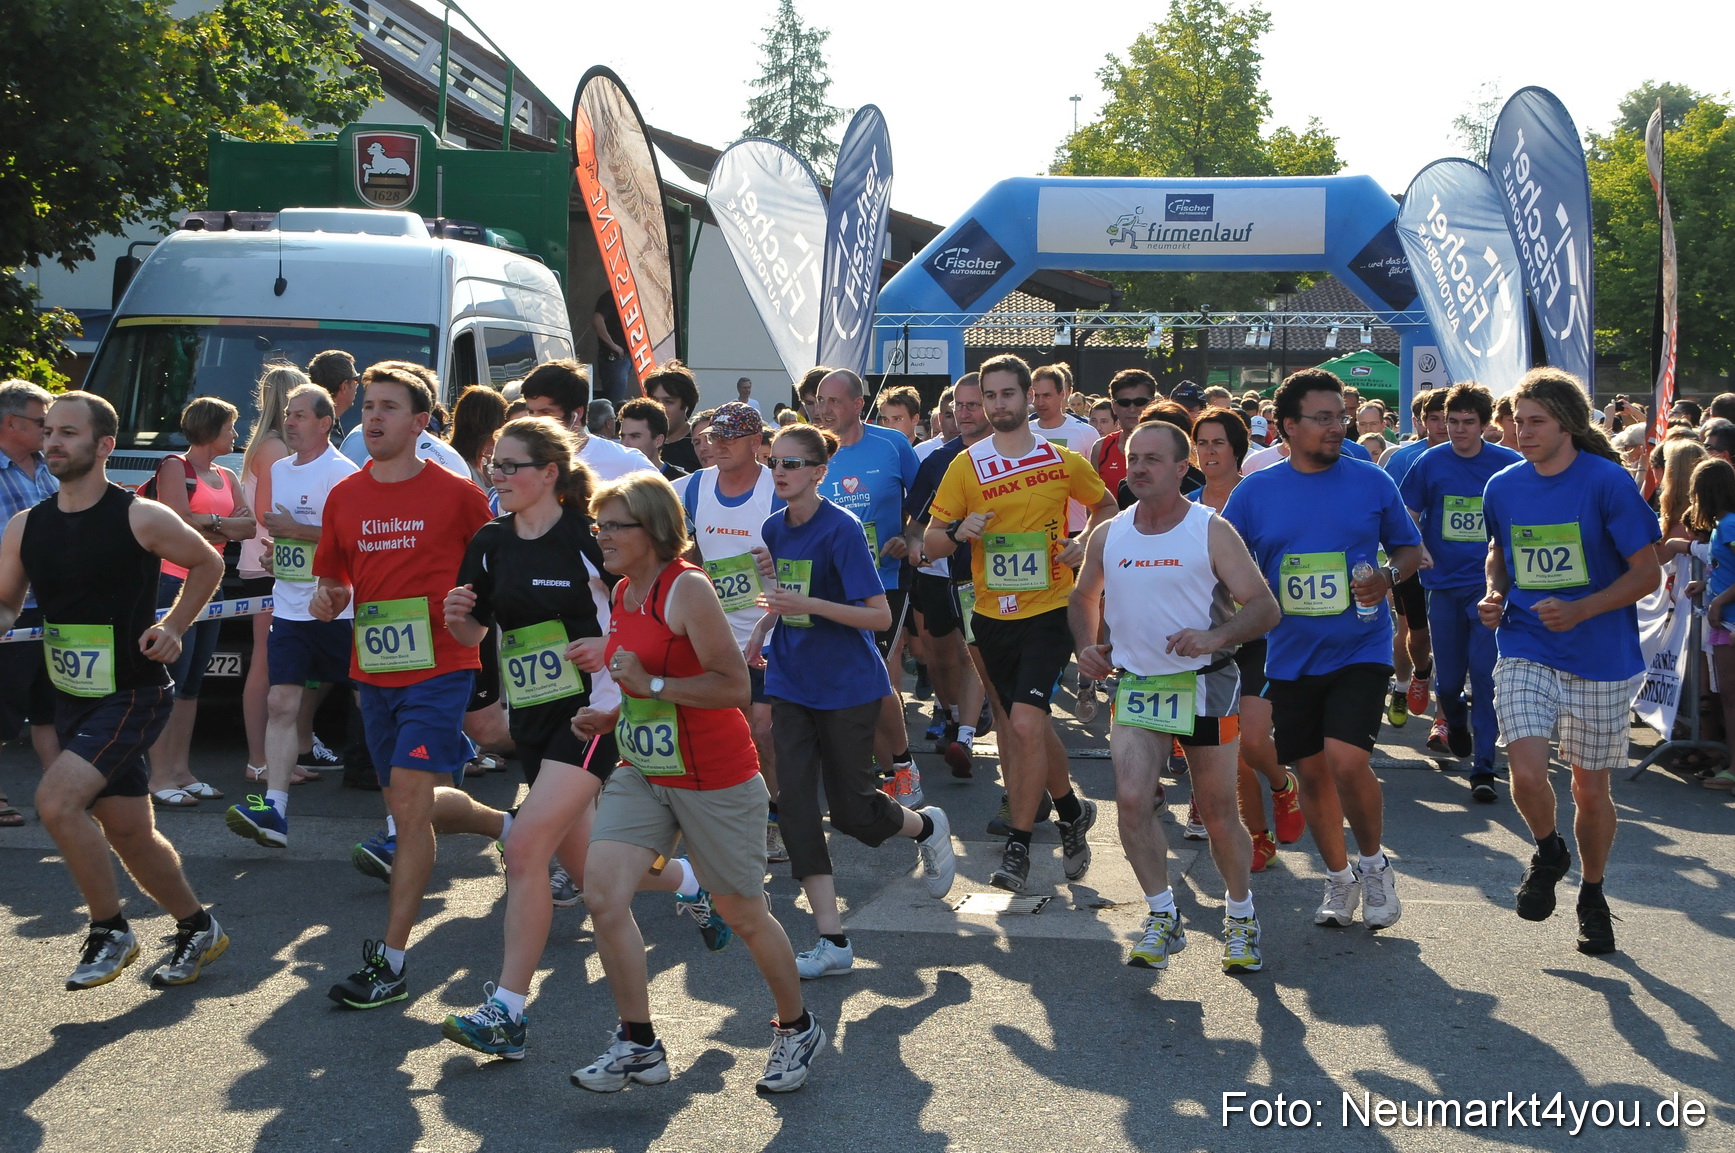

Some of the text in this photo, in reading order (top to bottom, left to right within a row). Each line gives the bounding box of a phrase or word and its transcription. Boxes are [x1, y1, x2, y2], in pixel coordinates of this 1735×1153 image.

[373, 190, 400, 201] 1628
[1175, 203, 1211, 212] Fischer
[845, 144, 880, 311] Fischer
[1148, 222, 1254, 243] firmenlauf
[862, 176, 884, 309] AUTOMOBILE
[1147, 242, 1191, 250] neumarkt
[945, 257, 1002, 269] Fischer
[1368, 259, 1384, 268] und
[1385, 256, 1401, 265] das
[832, 481, 841, 497] I
[981, 468, 1070, 501] MAX BÖGL
[834, 492, 870, 504] camping
[361, 517, 425, 536] Klinikum
[716, 527, 752, 537] KLEBL
[1450, 512, 1484, 531] 687
[357, 535, 417, 553] Neumarkt
[275, 544, 306, 569] 886
[992, 552, 1038, 577] 814
[1134, 559, 1184, 568] KLEBL
[1520, 546, 1573, 574] 702
[537, 579, 571, 588] PFLEIDERER
[714, 573, 752, 600] 528
[1287, 574, 1338, 600] 615
[364, 623, 416, 655] 601
[51, 647, 100, 679] 597
[508, 649, 562, 688] 979
[1126, 691, 1179, 720] 511
[618, 717, 675, 757] 1303
